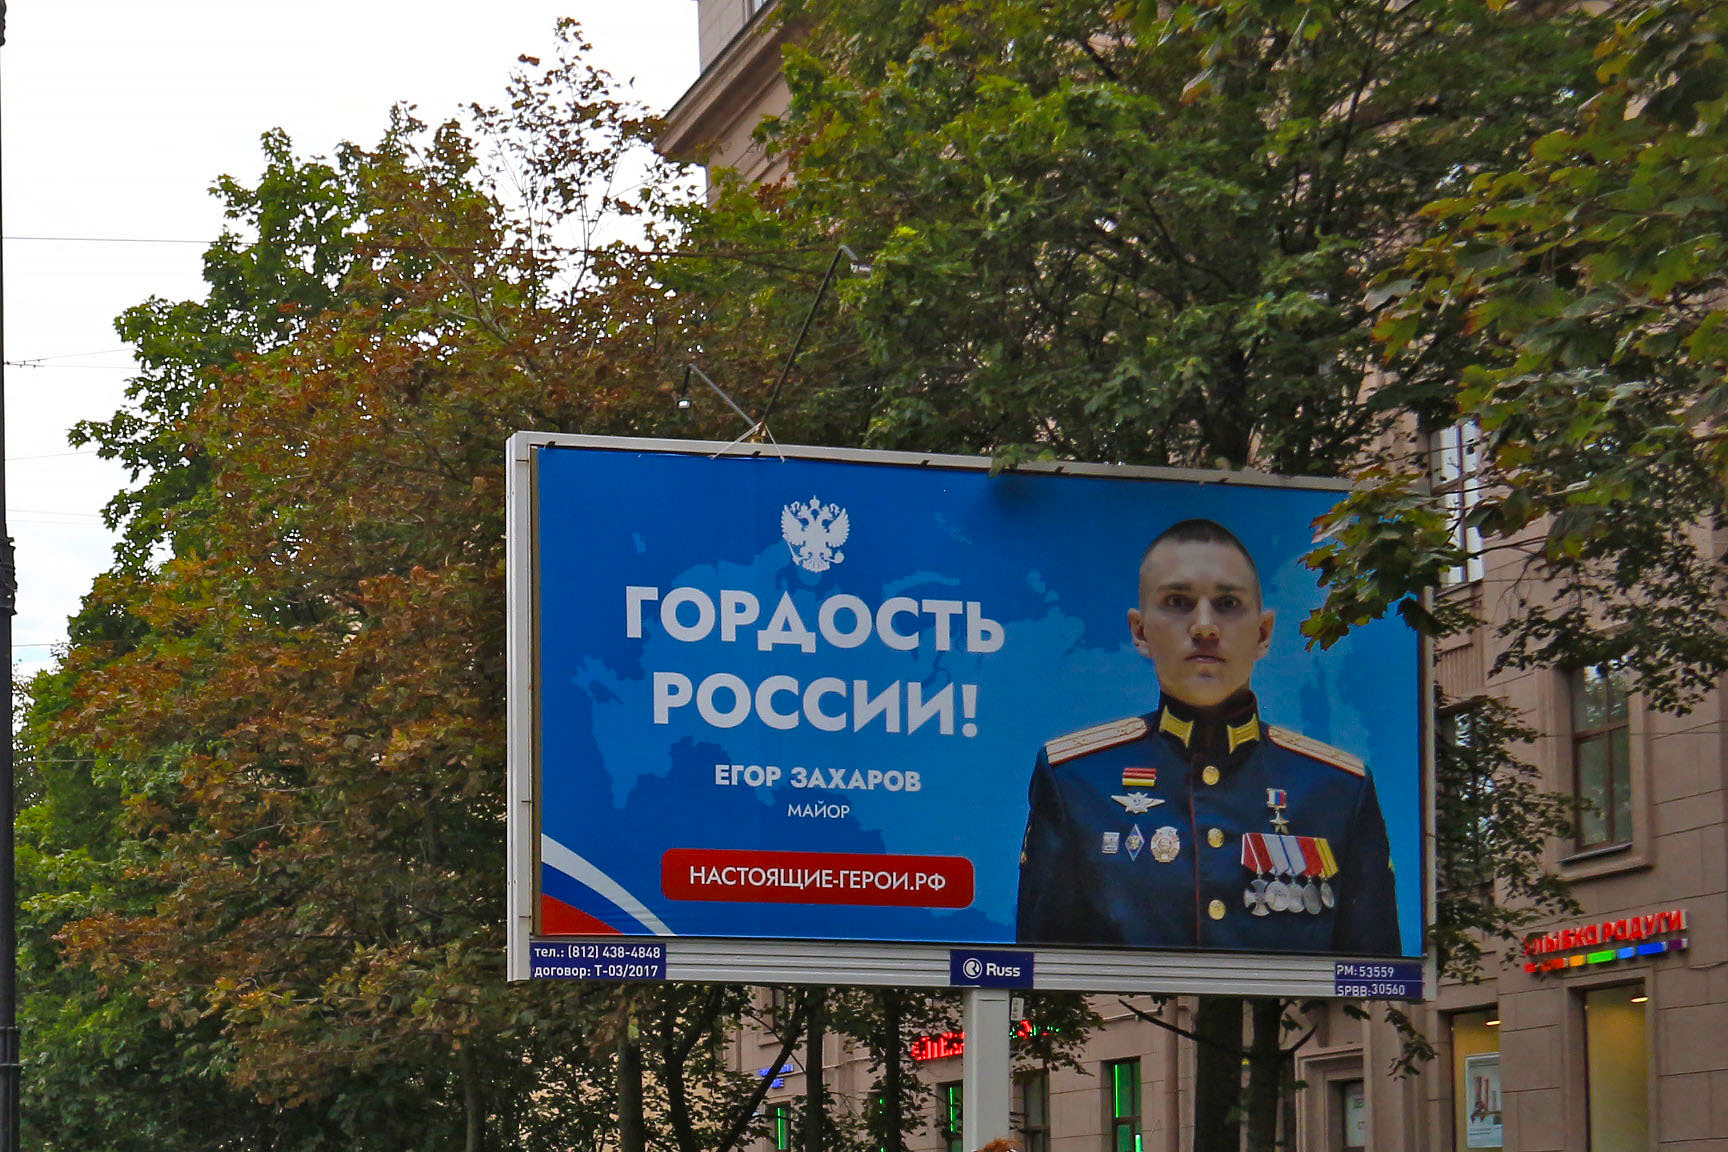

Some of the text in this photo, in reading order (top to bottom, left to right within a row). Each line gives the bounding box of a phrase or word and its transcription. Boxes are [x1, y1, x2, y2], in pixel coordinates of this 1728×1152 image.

[625, 585, 1005, 654] ГОРДОСТЬ
[653, 671, 978, 738] РОССИИ!
[714, 764, 922, 792] ЕГОР ЗАХАРОВ
[787, 800, 850, 819] МАЙОР
[689, 866, 946, 892] НАСТОЯЩИЕ-ГЕРОИ.РФ
[534, 944, 661, 959] тел.: (812) 438-4848
[534, 966, 591, 979] договор:
[986, 962, 1021, 977] Russ
